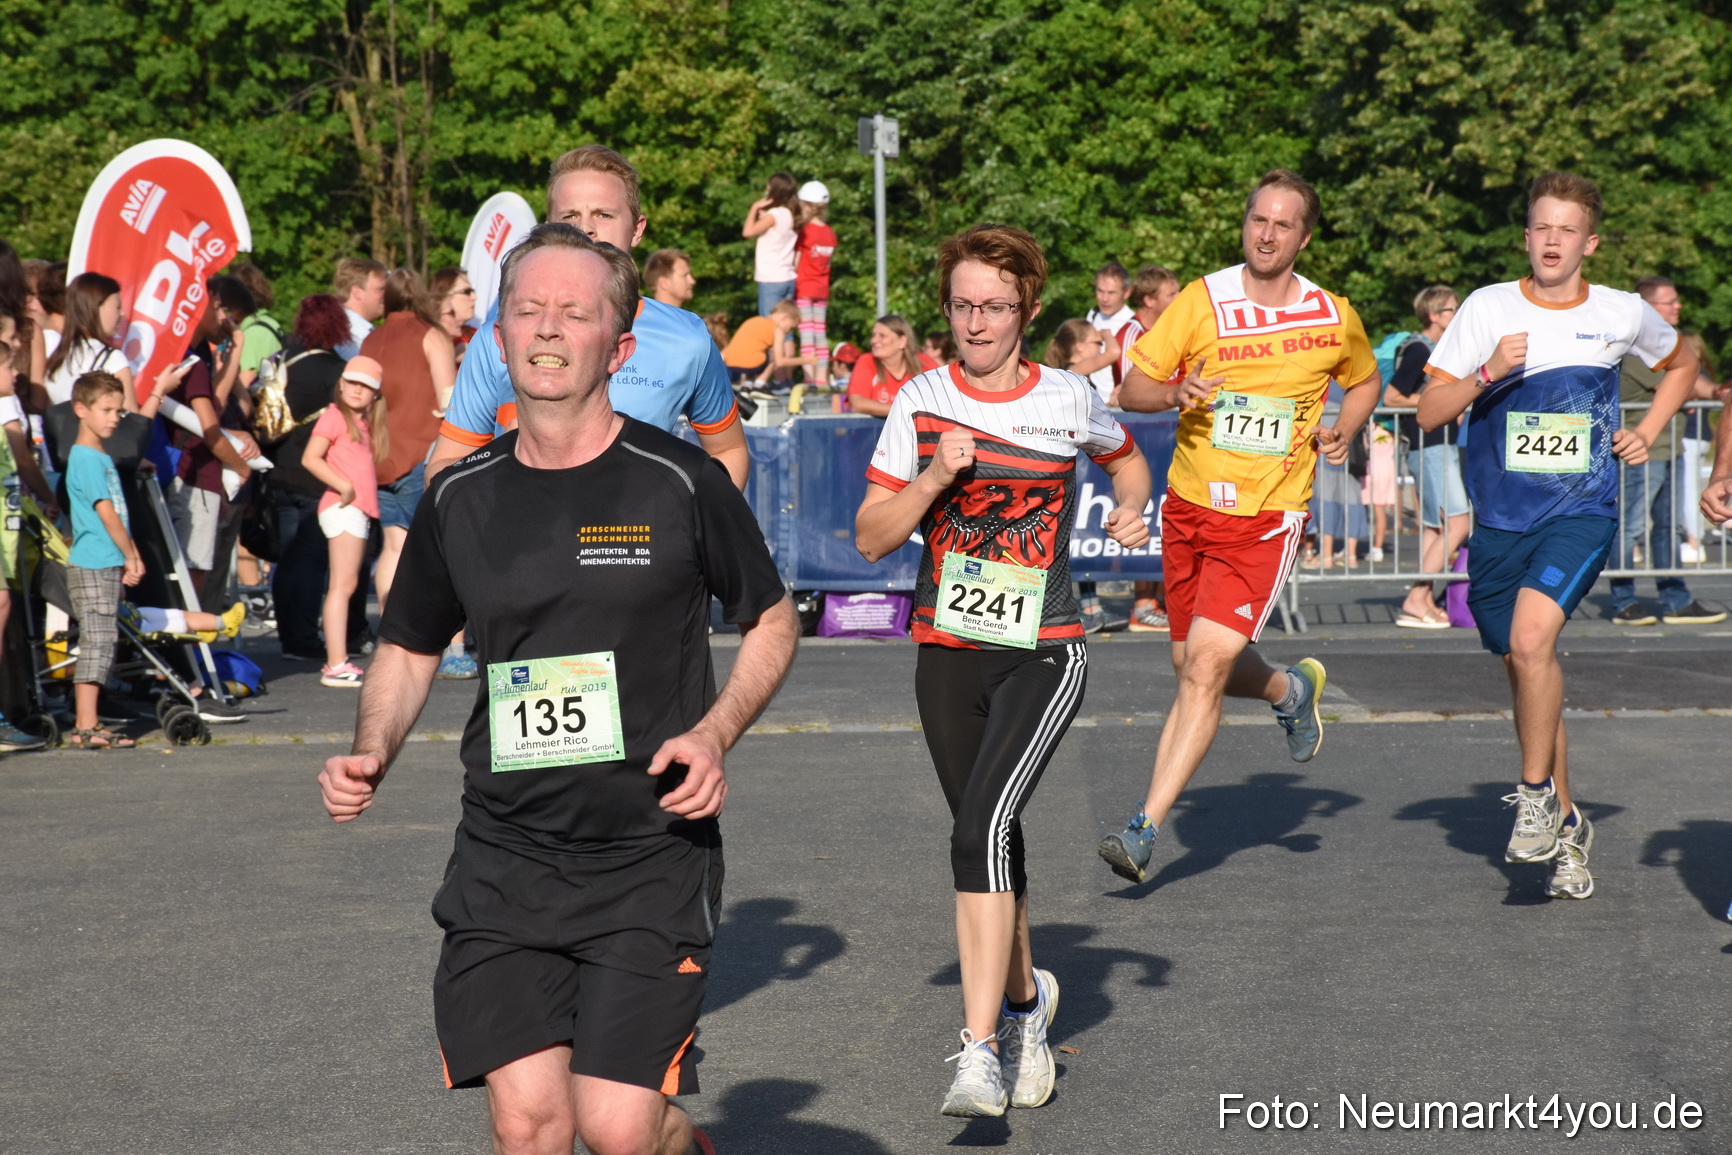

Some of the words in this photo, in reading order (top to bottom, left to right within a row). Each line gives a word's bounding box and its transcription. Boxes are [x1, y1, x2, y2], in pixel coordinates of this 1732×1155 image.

[119, 179, 152, 227] AVIA
[483, 212, 505, 254] AVIA
[1218, 342, 1275, 362] MAX
[1282, 332, 1342, 354] BÖGL
[651, 379, 664, 388] eG
[1012, 425, 1067, 438] NEUMARKT
[1224, 413, 1280, 440] 1711
[1515, 434, 1579, 456] 2424
[466, 451, 491, 463] JAKO
[580, 525, 651, 534] BERSCHNEIDER
[580, 535, 651, 543] BERSCHNEIDER
[580, 548, 628, 556] ARCHITEKTEN
[635, 548, 651, 556] BDA
[580, 558, 651, 566] INNENARCHITEKTEN
[1018, 588, 1038, 597] 2019
[947, 583, 1025, 624] 2241
[962, 615, 981, 626] Benz
[983, 619, 1008, 631] Gerda
[963, 623, 978, 632] Stadt
[977, 626, 1004, 636] Neumarkt
[504, 679, 549, 695] firmenlauf
[581, 682, 607, 693] 2019
[513, 695, 587, 738] 135
[515, 739, 560, 751] Lehmeier
[563, 736, 588, 746] Rico
[496, 752, 535, 761] Berschneider
[542, 747, 590, 757] Berschneider
[591, 743, 616, 752] GmbH
